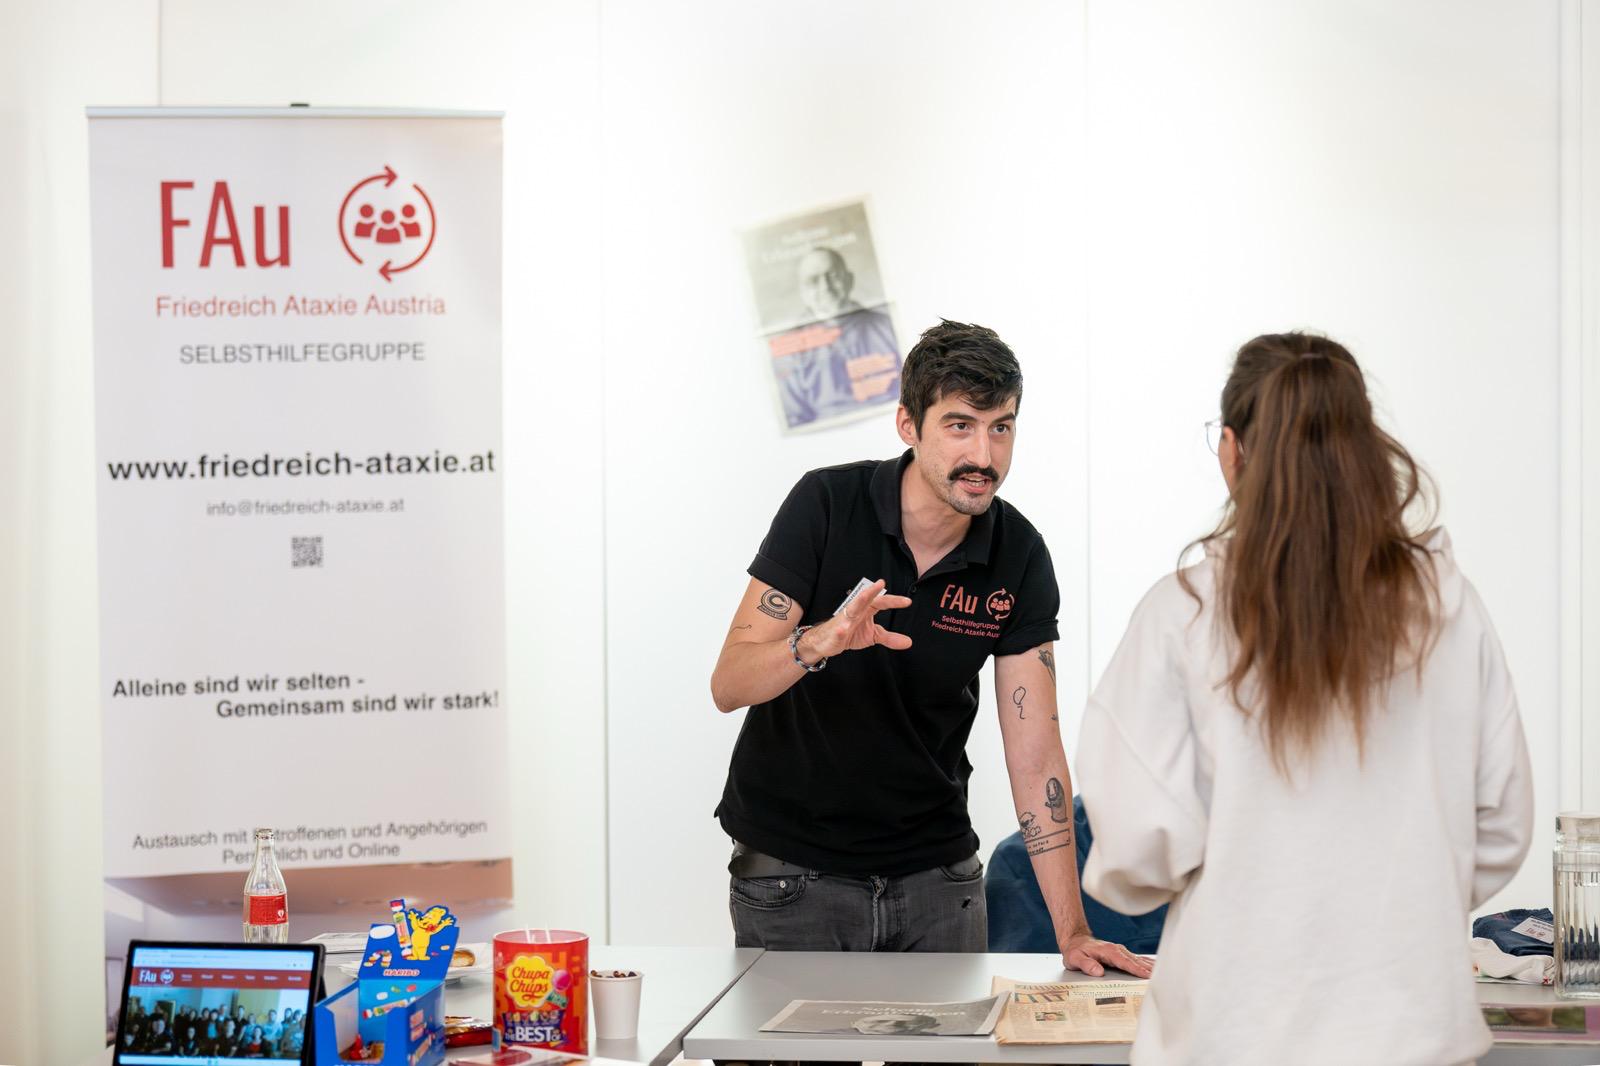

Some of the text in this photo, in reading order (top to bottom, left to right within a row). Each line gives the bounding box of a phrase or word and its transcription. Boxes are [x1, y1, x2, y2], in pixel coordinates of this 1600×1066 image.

[160, 181, 291, 269] FAu
[156, 294, 446, 317] Friedreich Ataxie Austria
[179, 342, 425, 364] SELBSTHILFEGRUPPE
[107, 449, 496, 480] www.friedreich-ataxie.at
[206, 498, 405, 516] info@friedreich-ataxie.at
[940, 584, 979, 614] FAu
[931, 620, 963, 634] Friedreich
[942, 615, 1000, 630] Selbsthilfegruppe
[113, 680, 186, 697] Alleine
[194, 677, 239, 695] sind
[247, 676, 280, 692] wir
[287, 673, 350, 691] selten
[216, 691, 499, 718] Gemeinsam sind wir stark!
[133, 819, 488, 849] Austausch mit troffenen und Angehörigen
[313, 844, 343, 860] und
[348, 841, 401, 859] Online
[139, 970, 157, 982] FAu
[383, 969, 420, 977] HARIBO
[512, 966, 550, 984] Chupa
[510, 980, 548, 1000] Chups
[515, 1026, 554, 1042] BEST
